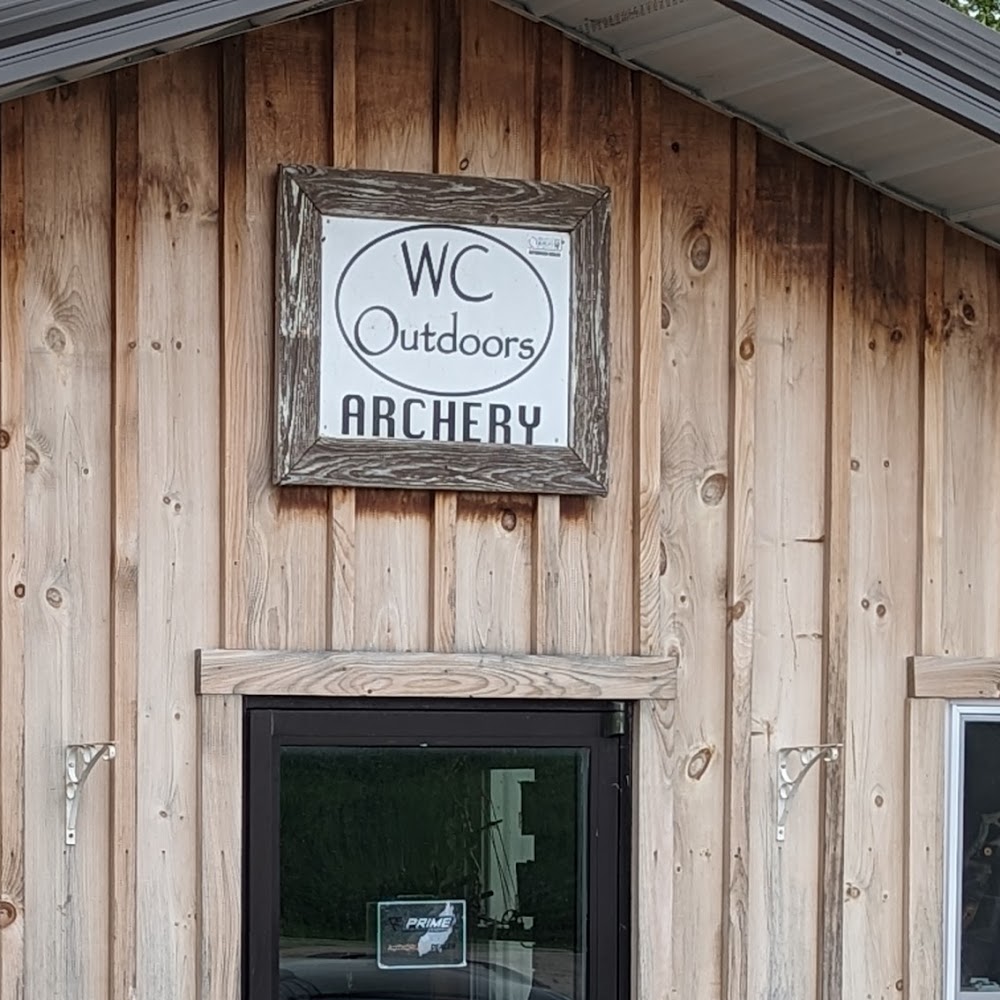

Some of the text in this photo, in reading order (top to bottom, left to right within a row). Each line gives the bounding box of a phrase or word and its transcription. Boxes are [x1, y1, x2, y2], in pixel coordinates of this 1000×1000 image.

[400, 240, 494, 303] WC
[354, 305, 535, 360] Outdoors
[341, 394, 542, 446] ARCHERY
[405, 917, 452, 930] PRIME
